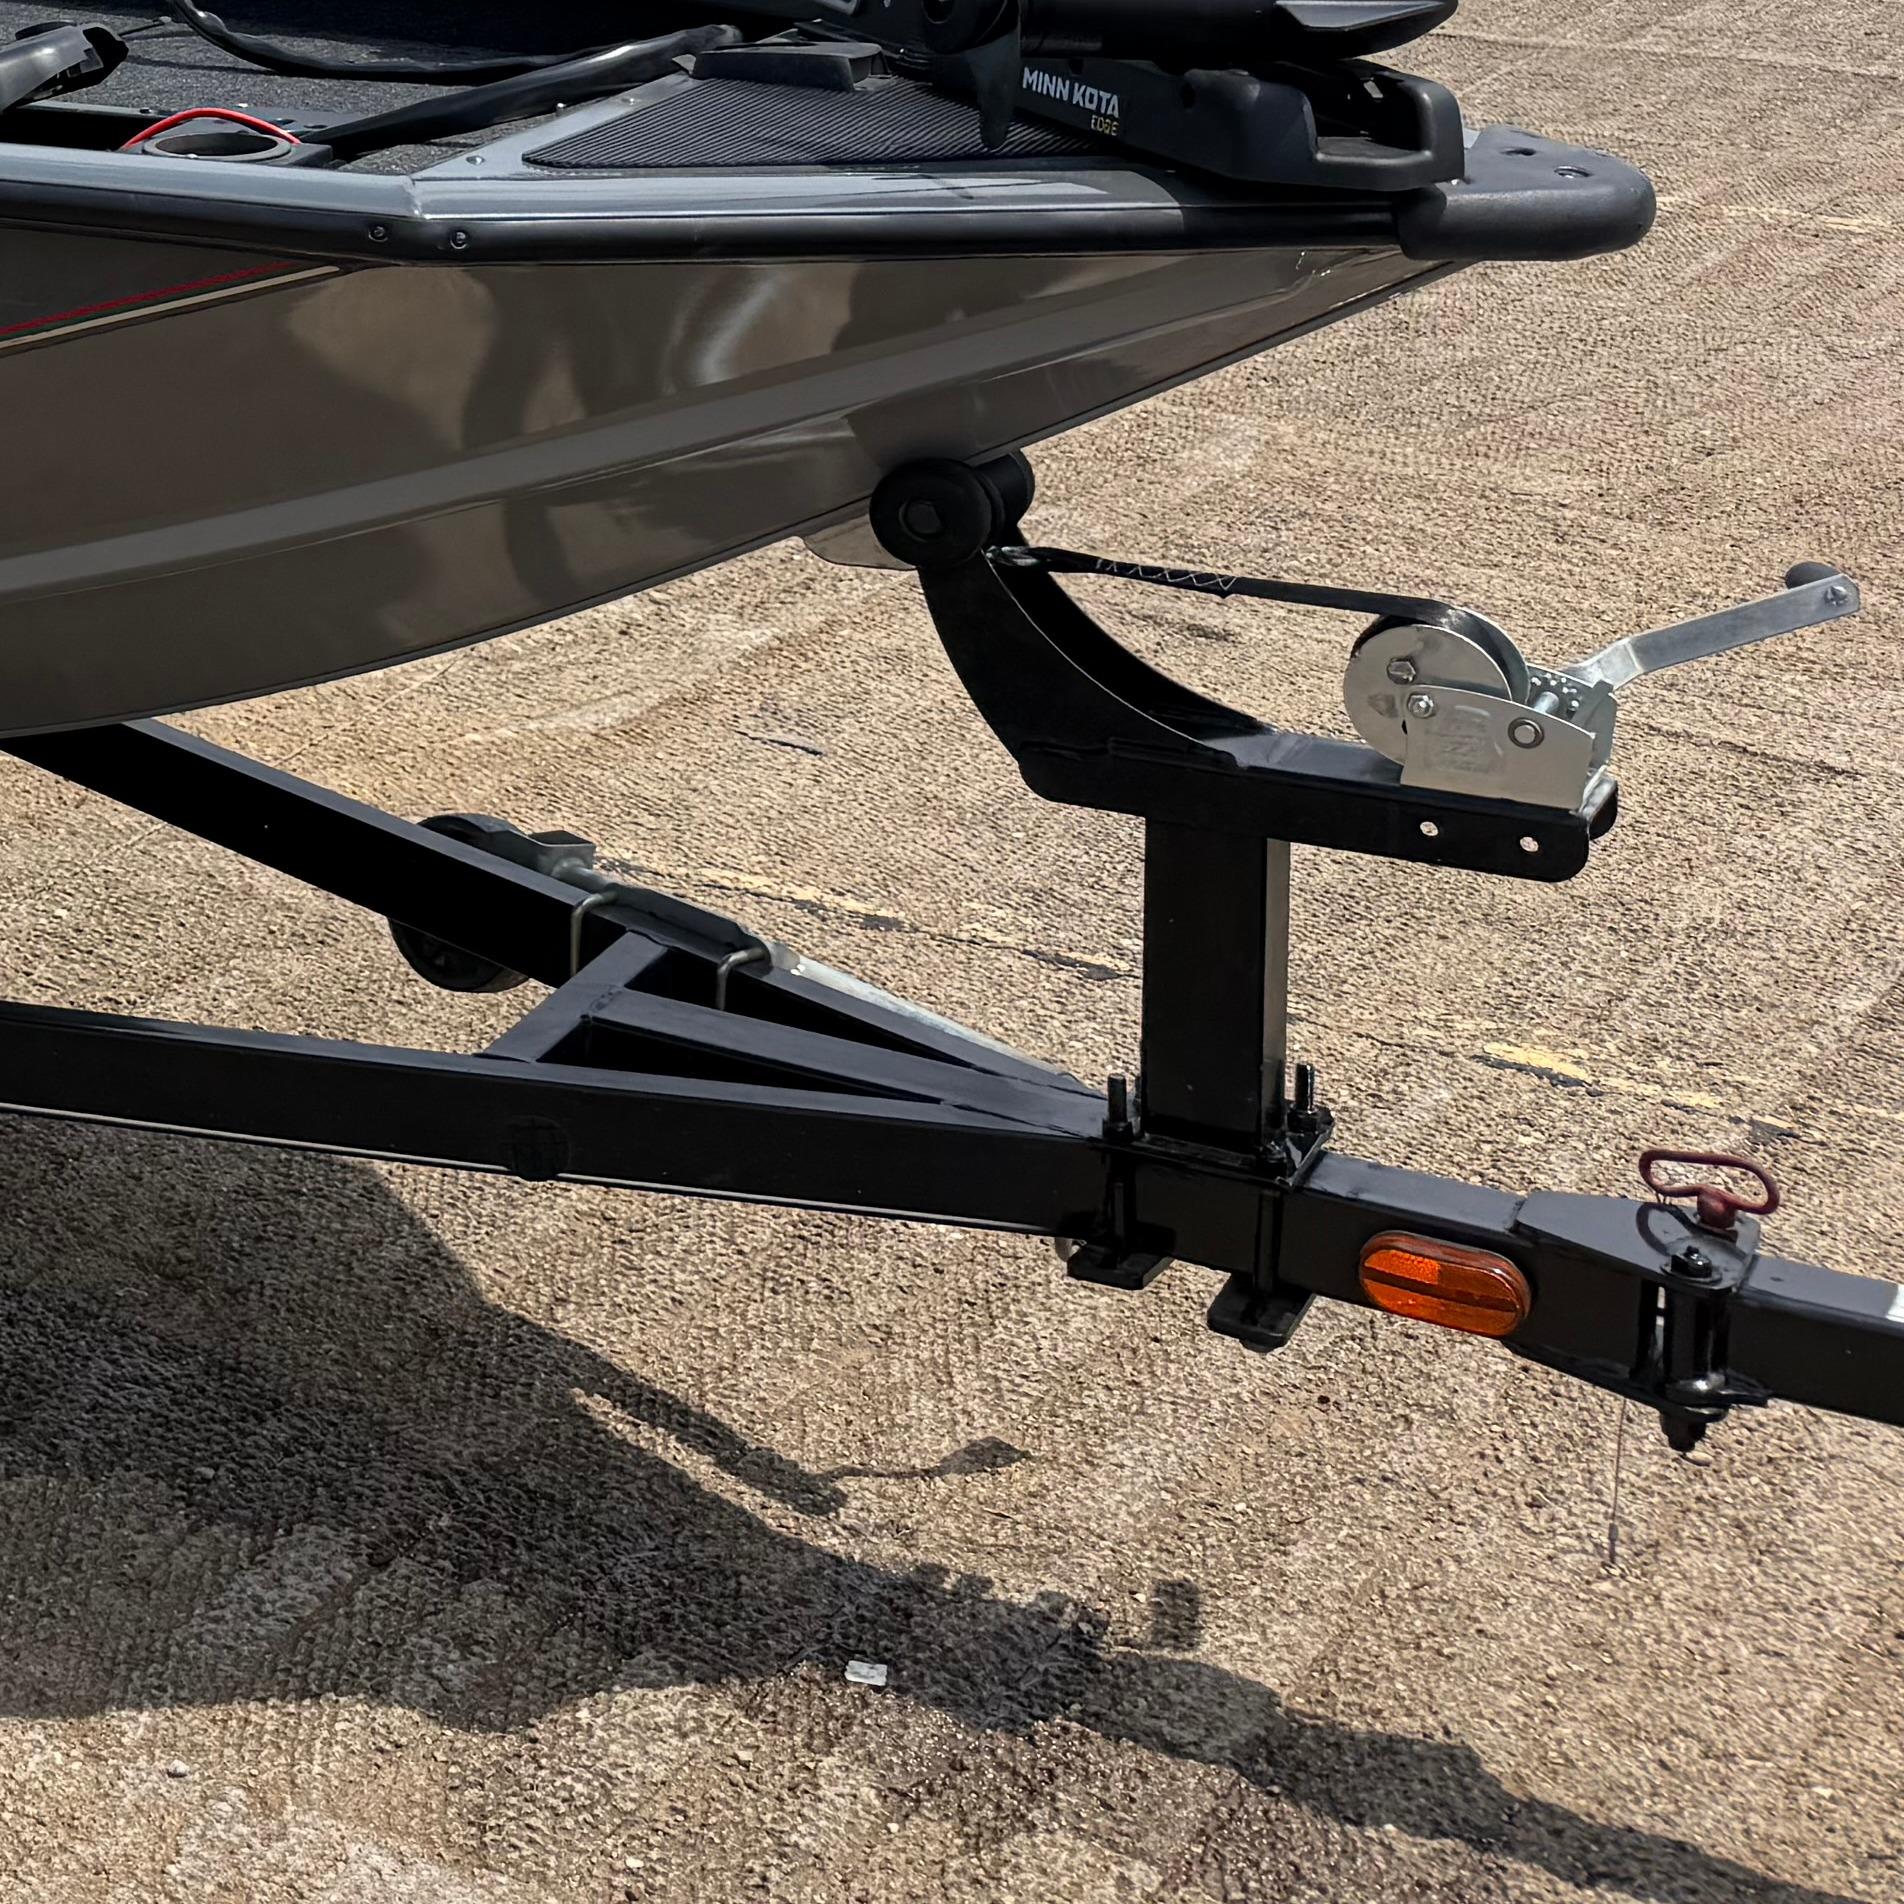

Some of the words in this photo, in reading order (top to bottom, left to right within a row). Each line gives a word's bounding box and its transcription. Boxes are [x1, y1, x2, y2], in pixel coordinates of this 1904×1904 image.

[1022, 66, 1070, 102] MINN
[1072, 82, 1120, 119] KOTA
[1091, 114, 1120, 136] EDGE
